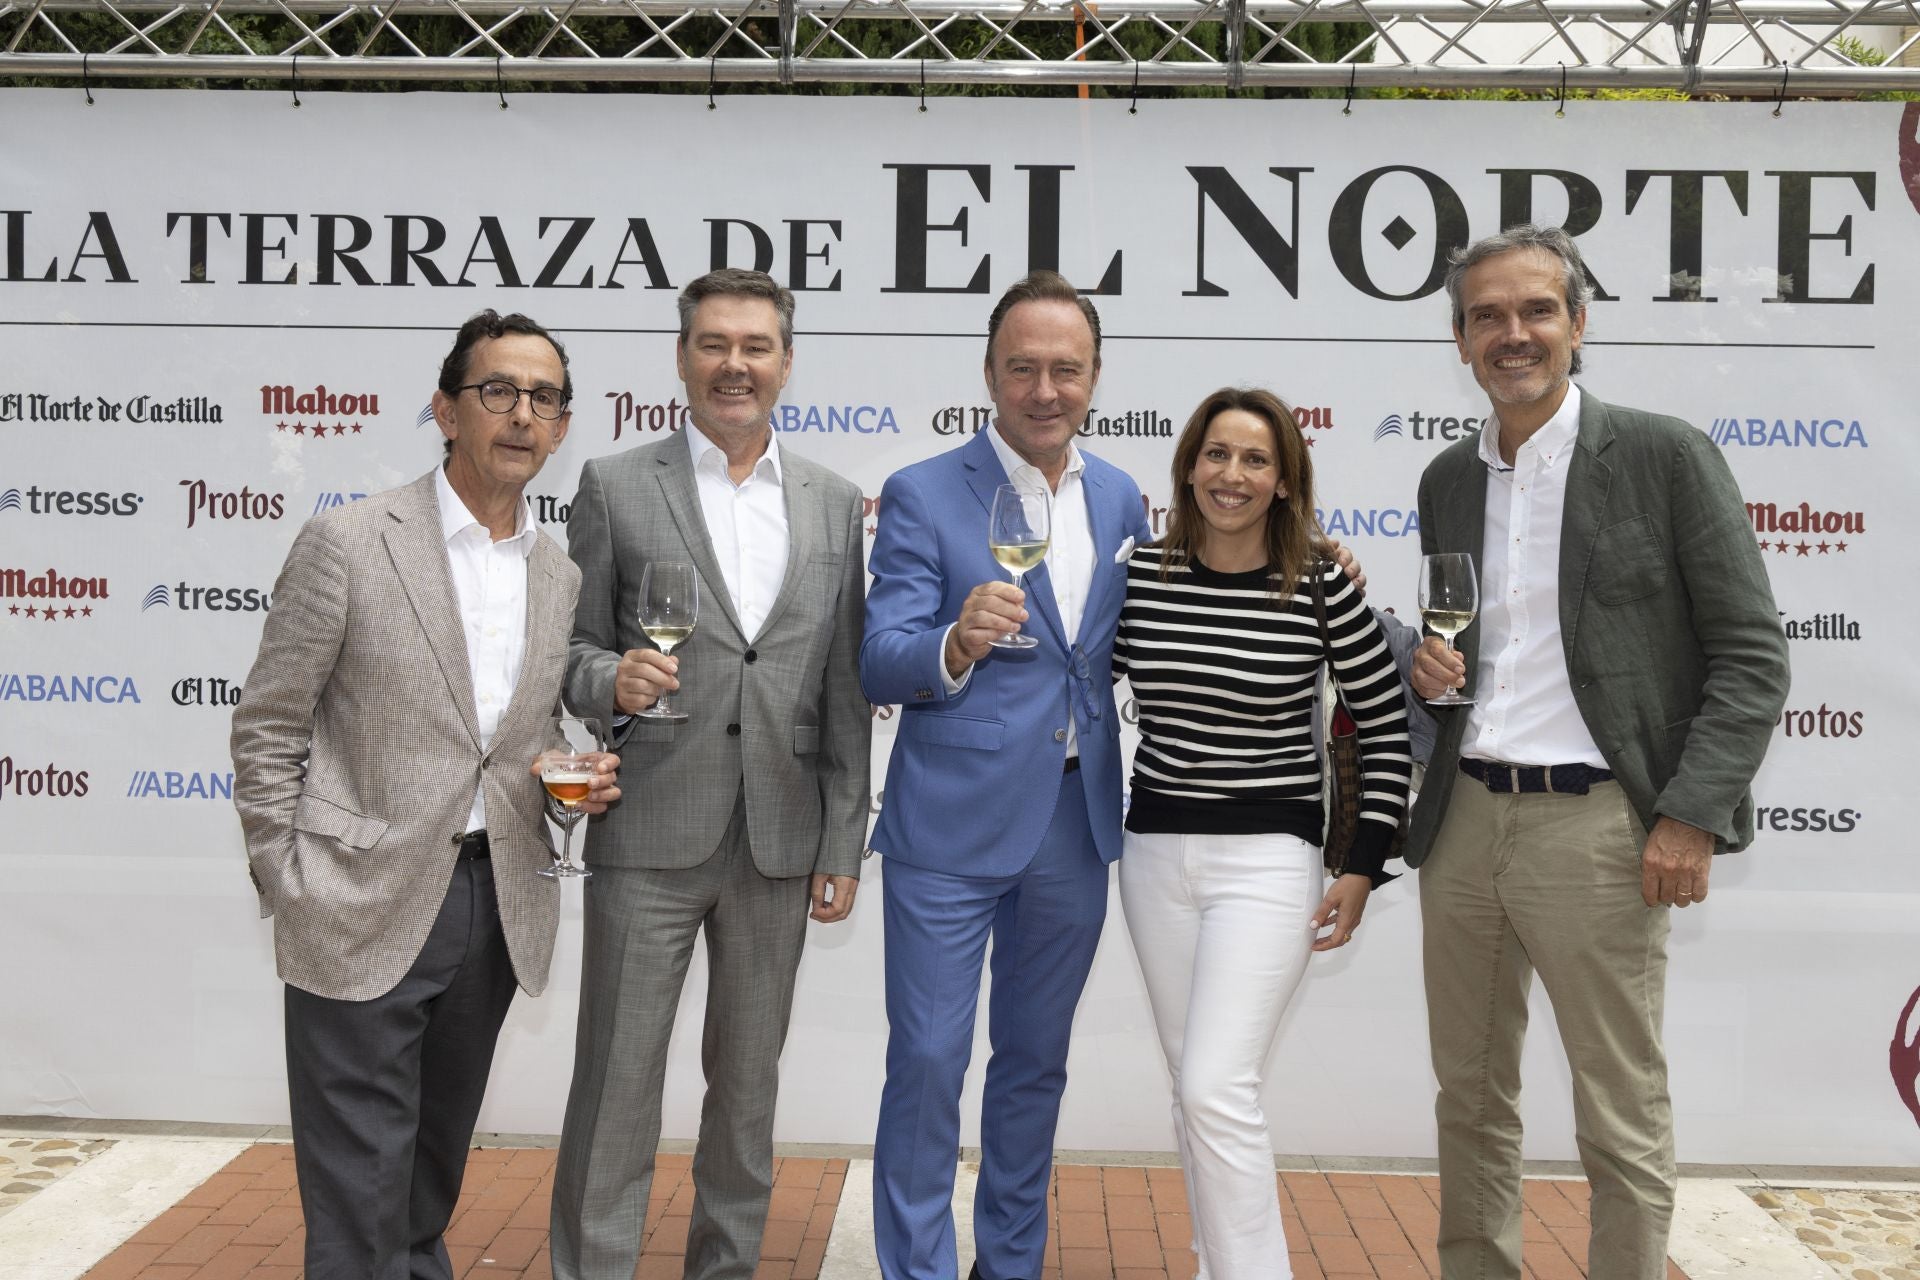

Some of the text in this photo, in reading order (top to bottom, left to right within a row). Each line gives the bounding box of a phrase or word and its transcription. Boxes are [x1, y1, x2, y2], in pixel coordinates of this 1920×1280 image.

[0, 163, 1877, 305] LA TERRAZA DE EL NORTE
[0, 393, 224, 424] El Norte de Castilla
[260, 385, 380, 416] Mahou
[932, 406, 965, 436] El
[1076, 408, 1174, 437] Castilla
[26, 485, 144, 516] tressis
[178, 479, 285, 529] Protos
[1745, 502, 1866, 534] Mahou
[0, 568, 109, 599] Mahou
[174, 581, 274, 612] tressi
[1778, 611, 1862, 640] astilla
[171, 677, 203, 706] El
[1774, 702, 1864, 738] rotos
[141, 771, 234, 799] ABAN
[1757, 806, 1862, 832] ressis
